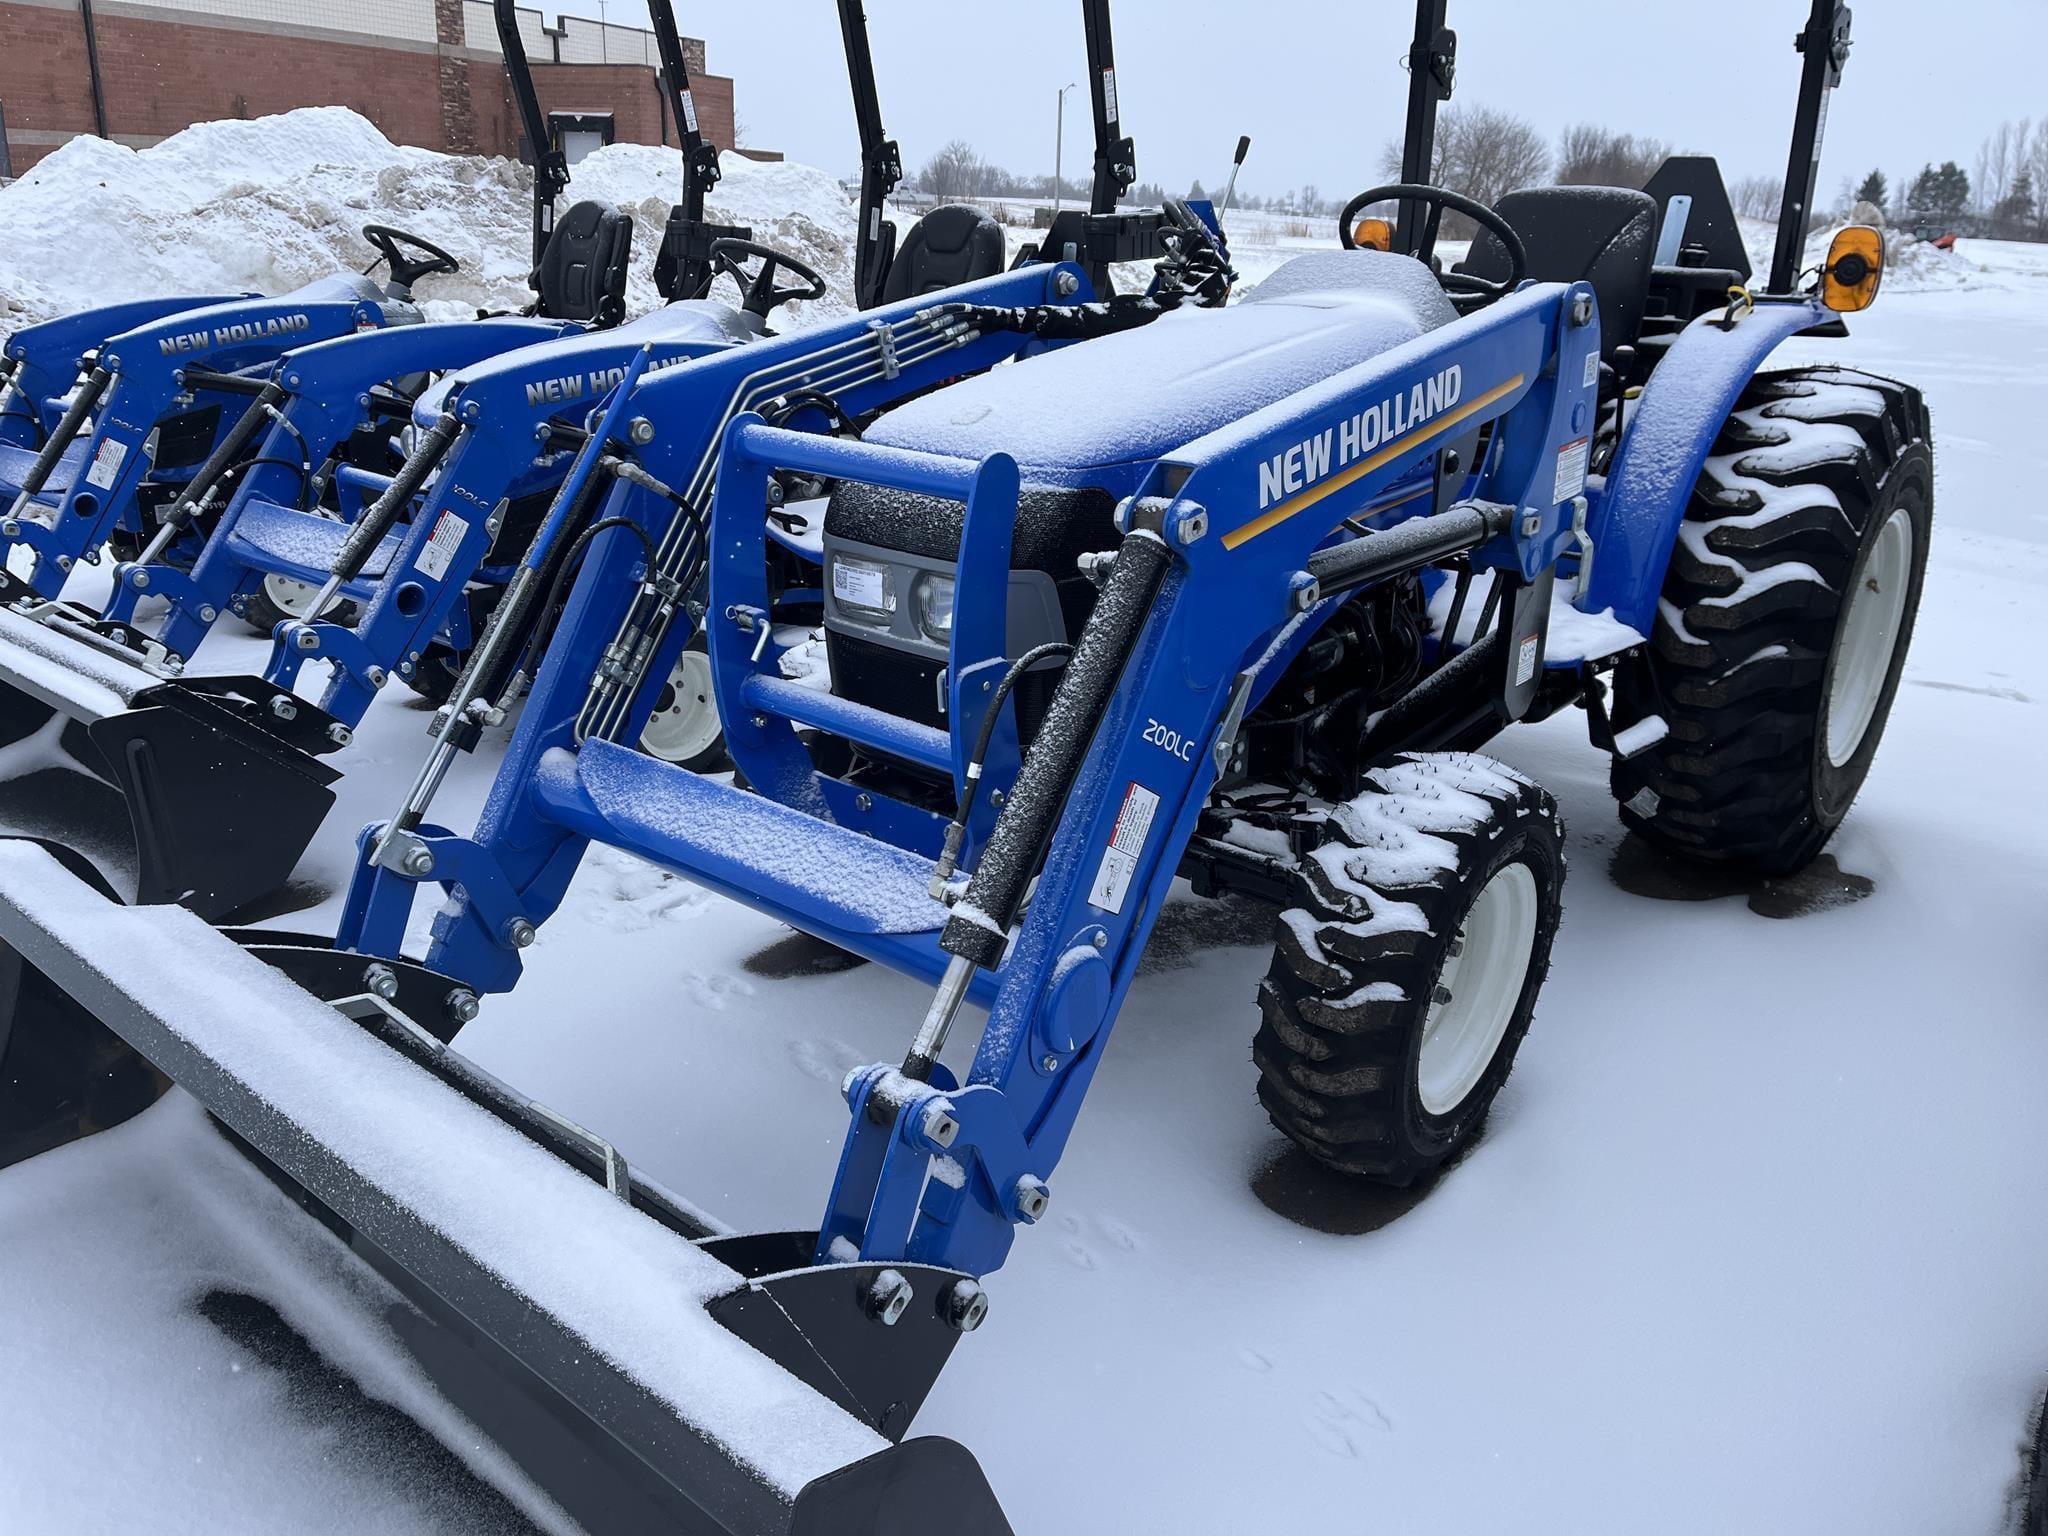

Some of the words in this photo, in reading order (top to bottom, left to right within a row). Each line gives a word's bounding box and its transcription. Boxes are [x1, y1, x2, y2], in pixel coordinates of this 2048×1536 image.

[158, 331, 209, 356] NEW
[213, 313, 309, 345] HOLLAND
[525, 374, 583, 407] NEW
[1259, 428, 1333, 510] NEW
[1339, 364, 1462, 467] HOLLAND
[1142, 717, 1195, 762] 200LC
